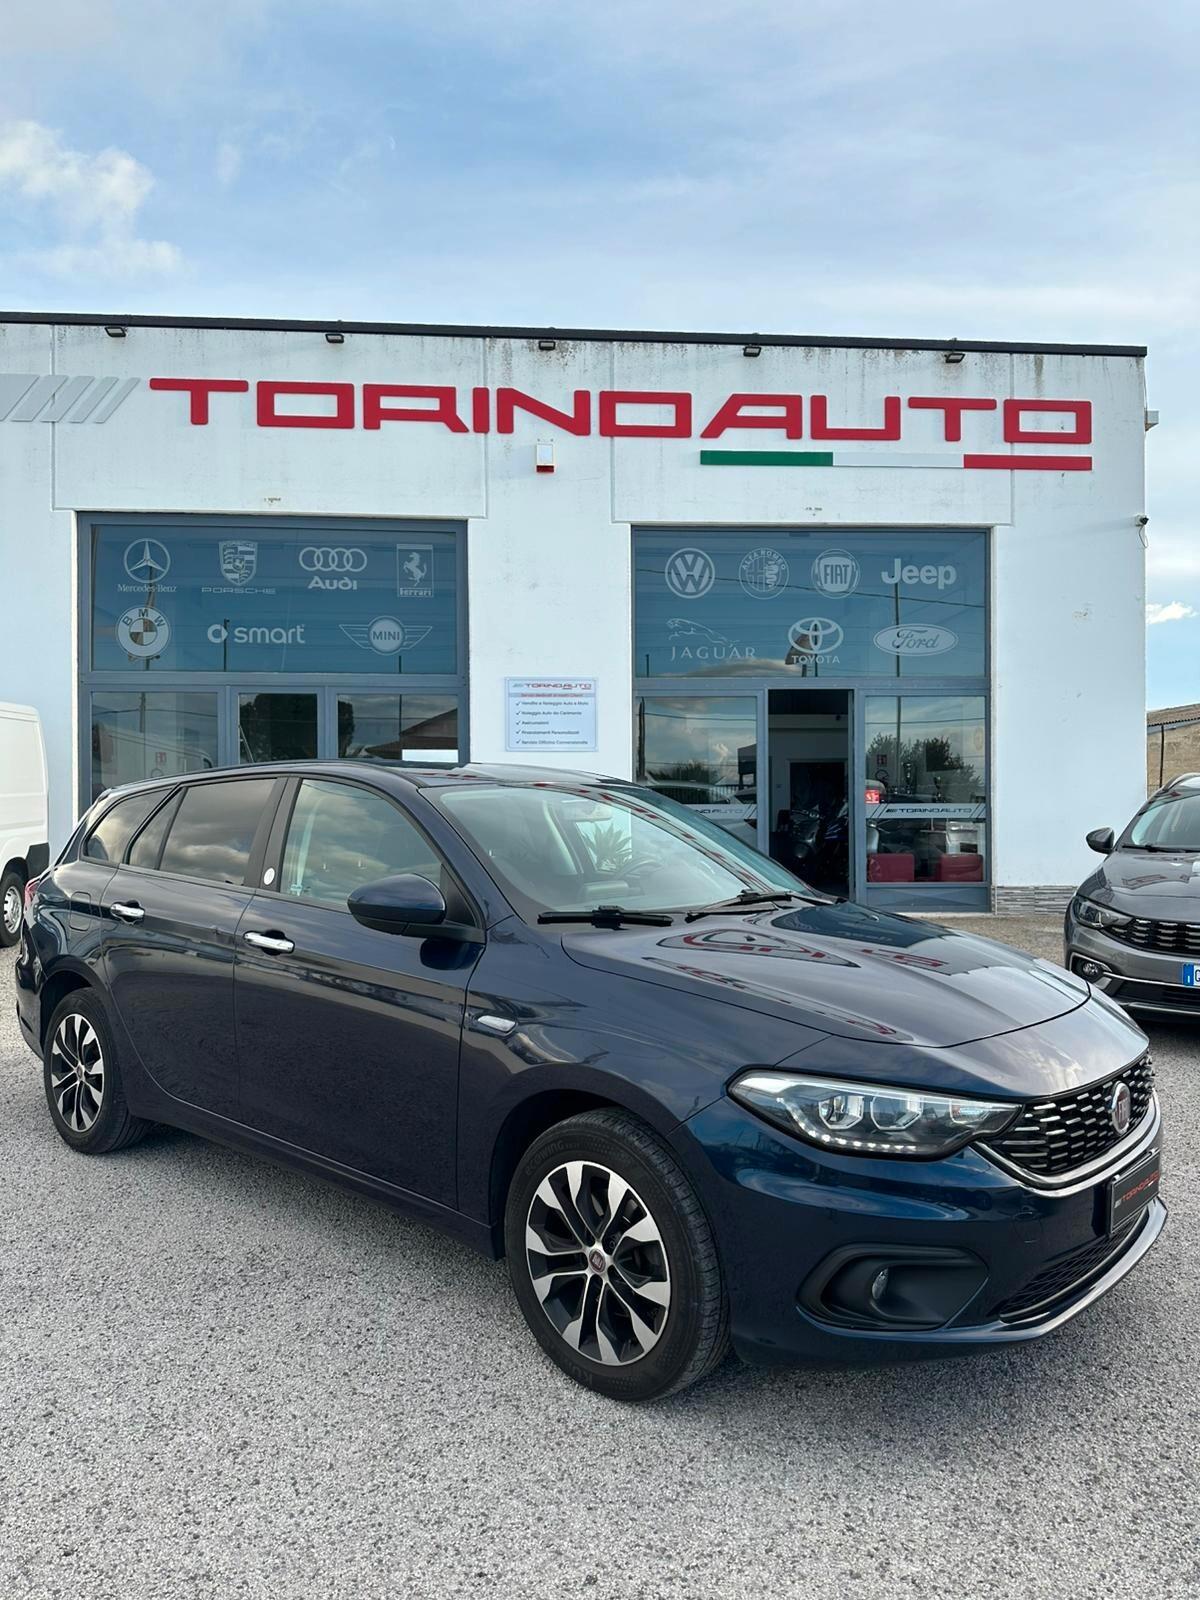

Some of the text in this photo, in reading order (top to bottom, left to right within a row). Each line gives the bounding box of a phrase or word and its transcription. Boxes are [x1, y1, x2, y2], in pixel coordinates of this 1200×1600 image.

[148, 377, 1093, 444] TORINOAUTO
[308, 575, 358, 590] Audi
[823, 564, 850, 585] FIAT
[881, 558, 957, 590] Jeep
[117, 583, 177, 593] Mercedes-Benz
[201, 586, 277, 595] PORSCHE
[121, 608, 166, 628] BMW
[233, 624, 305, 644] smart
[372, 631, 400, 641] MINI
[891, 629, 941, 649] Ford
[670, 646, 756, 662] JAGUAR
[791, 655, 841, 664] TOYOTA
